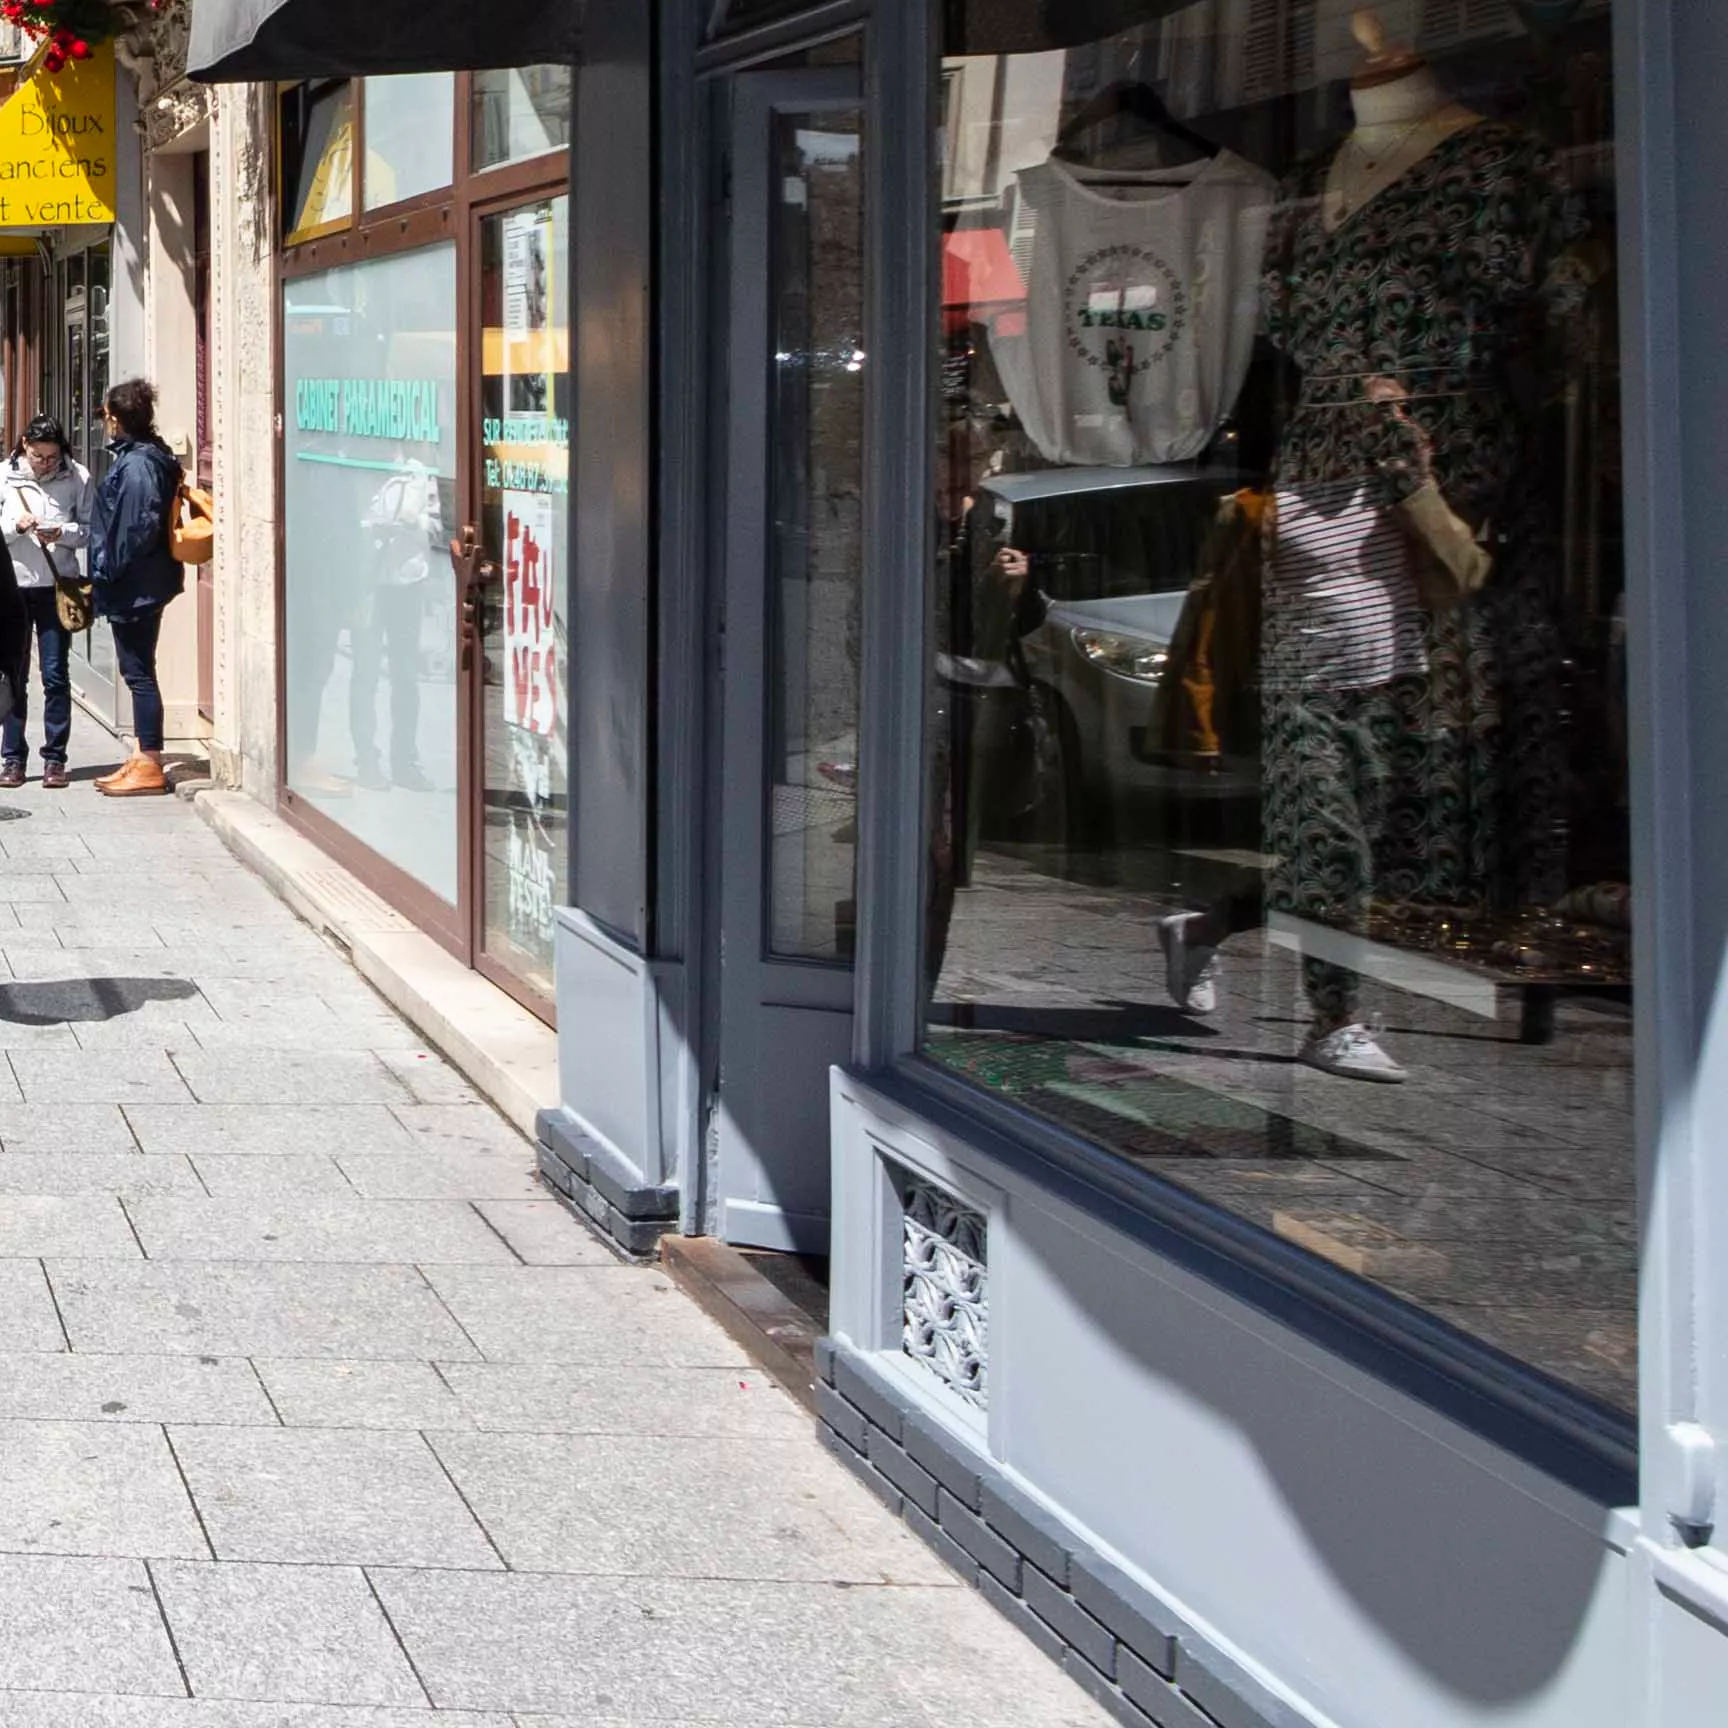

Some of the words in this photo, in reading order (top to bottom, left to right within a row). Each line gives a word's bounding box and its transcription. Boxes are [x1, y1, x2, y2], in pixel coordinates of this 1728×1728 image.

[20, 103, 105, 152] Bijoux
[0, 158, 106, 180] anciens
[25, 194, 103, 221] vente
[297, 378, 339, 433] CABINET
[343, 378, 440, 444] PARAMEDICAL
